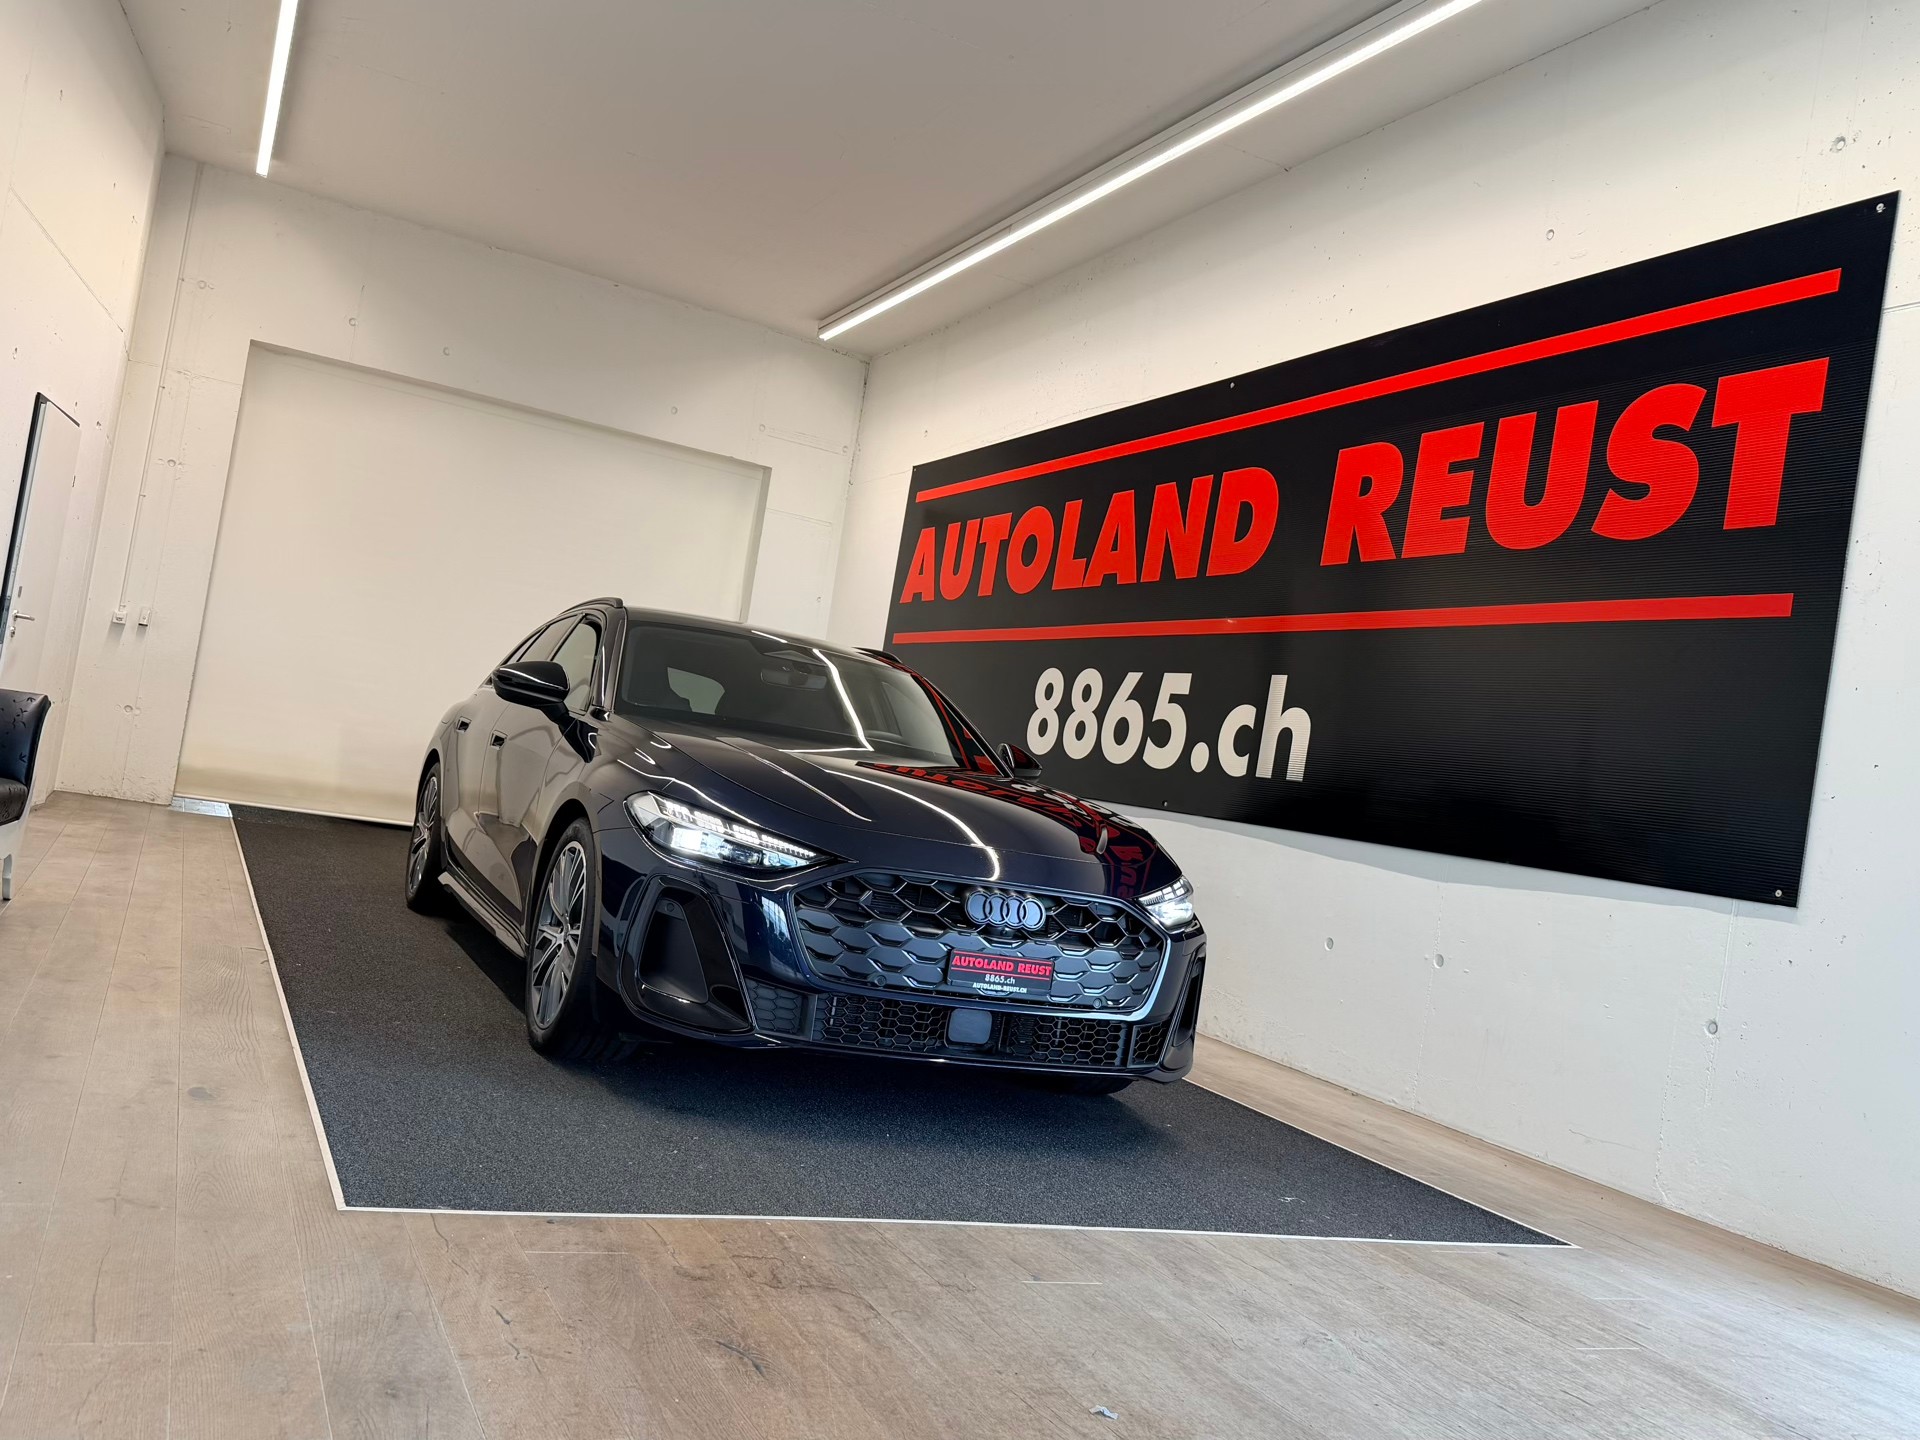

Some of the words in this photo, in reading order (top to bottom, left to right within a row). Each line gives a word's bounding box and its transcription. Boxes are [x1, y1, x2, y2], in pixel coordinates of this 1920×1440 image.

[900, 466, 1279, 604] AUTOLAND
[1320, 357, 1830, 566] REUST
[1026, 667, 1311, 779] 8865.ch
[952, 955, 1014, 971] AUTOLAND
[1018, 963, 1052, 976] REUST
[985, 974, 1015, 985] 8865.ch
